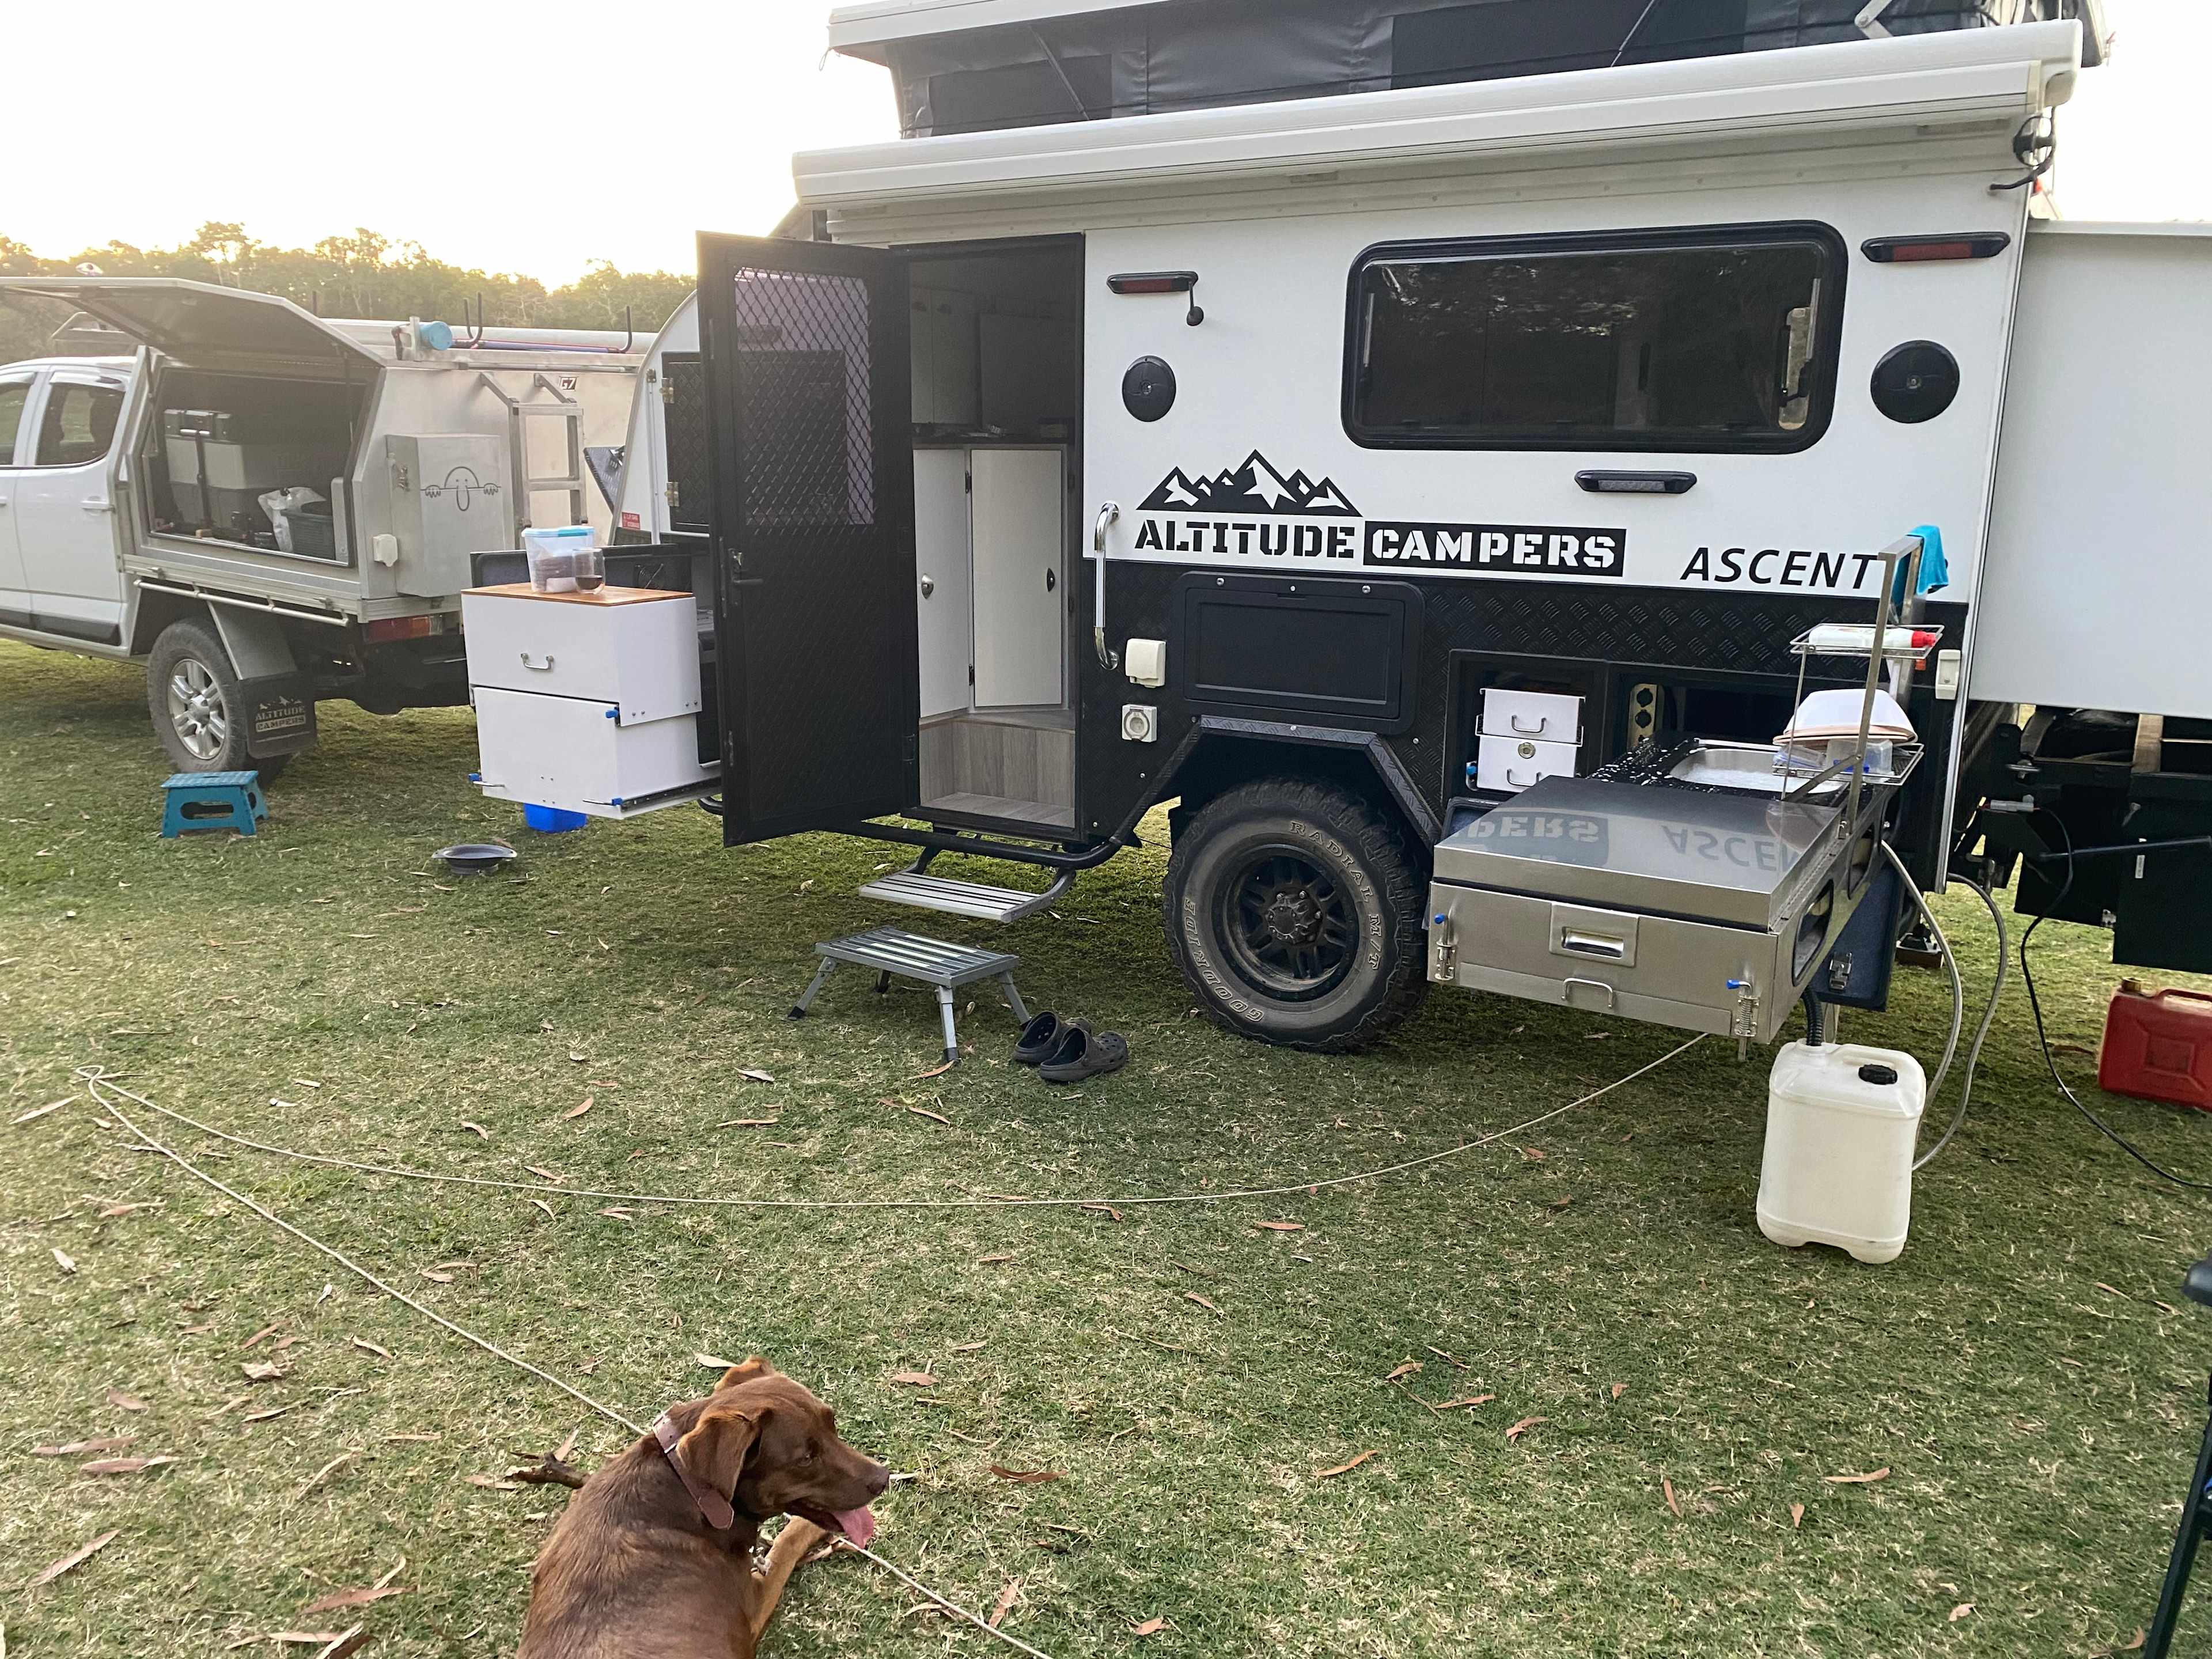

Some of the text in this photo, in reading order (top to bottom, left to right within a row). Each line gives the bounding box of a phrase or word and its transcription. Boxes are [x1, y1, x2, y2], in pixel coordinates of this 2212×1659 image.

[1134, 519, 1616, 569] ALTITUDE CAMPERS
[1679, 547, 1878, 589] ASCENT
[255, 705, 305, 721] ALTITUDE
[257, 717, 305, 731] CAMPERS
[1290, 820, 1382, 970] RADIAL M/T
[1184, 896, 1264, 1022] GOODRIDE
